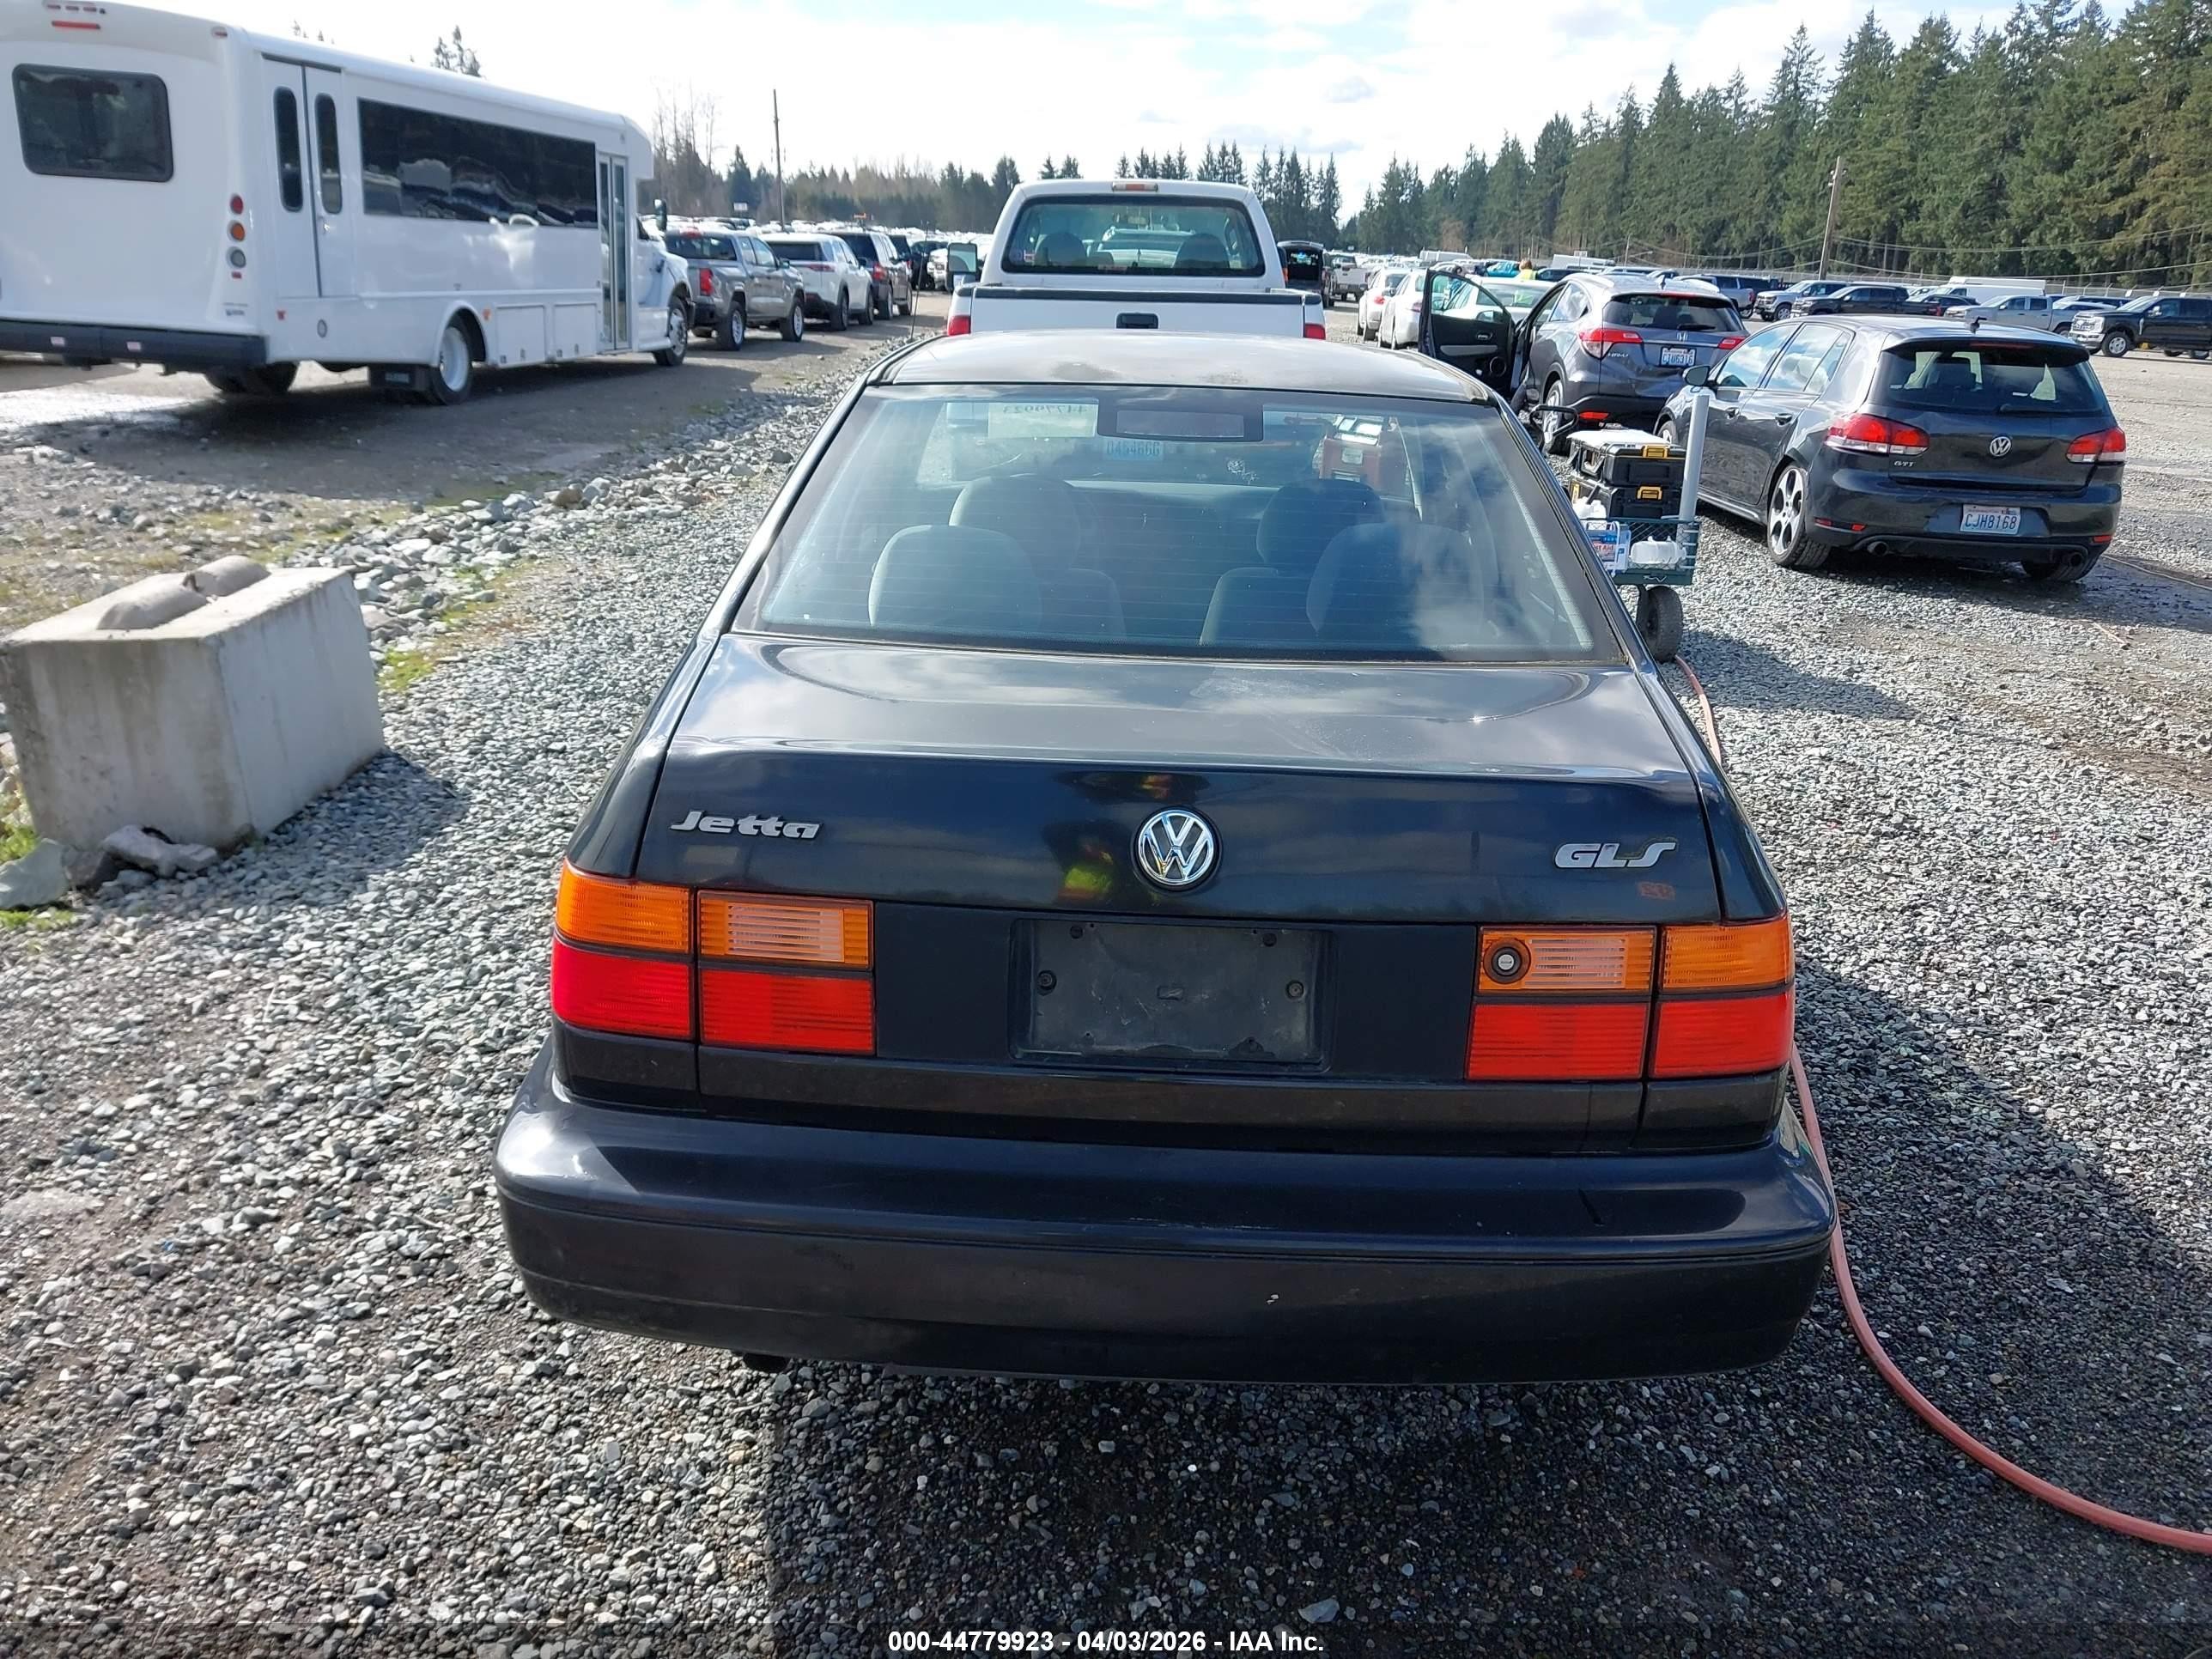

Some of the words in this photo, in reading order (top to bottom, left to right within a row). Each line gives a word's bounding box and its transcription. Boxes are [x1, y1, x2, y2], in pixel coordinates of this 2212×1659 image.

[1965, 514, 2017, 529] CJH8168
[670, 811, 820, 839] Jetta
[1555, 842, 1676, 868] GLS
